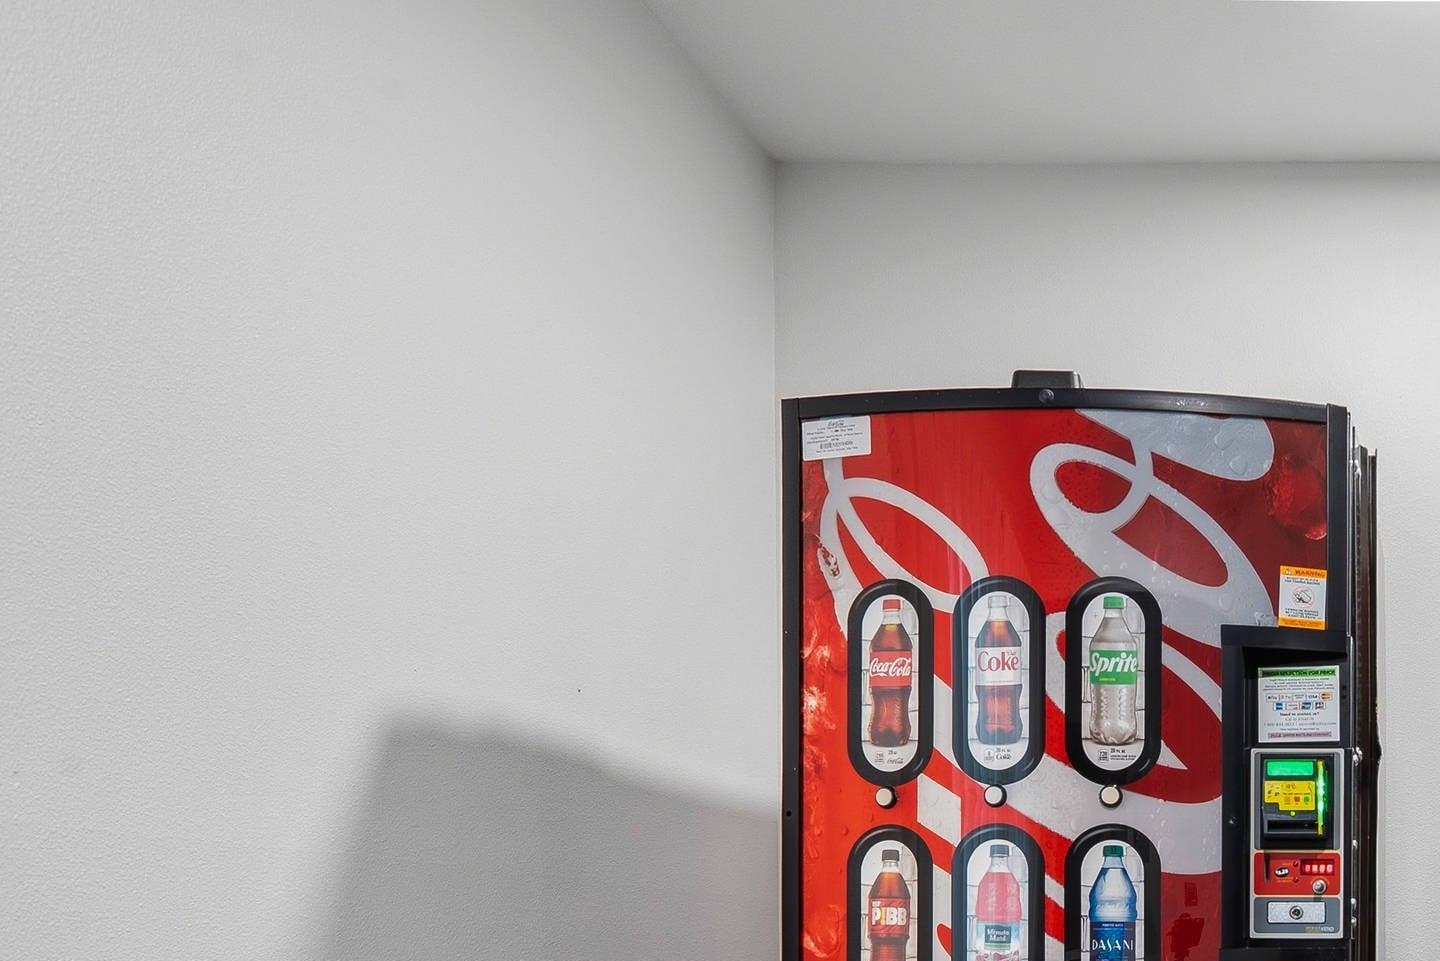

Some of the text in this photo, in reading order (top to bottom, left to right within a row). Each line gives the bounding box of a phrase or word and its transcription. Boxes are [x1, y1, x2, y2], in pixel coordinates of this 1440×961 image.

[869, 657, 912, 677] Coca-Cola
[977, 651, 1019, 672] Coke
[1089, 652, 1138, 677] Sprite
[871, 907, 907, 926] PIBB
[987, 928, 1010, 936] Minute
[1092, 939, 1133, 951] DASANI
